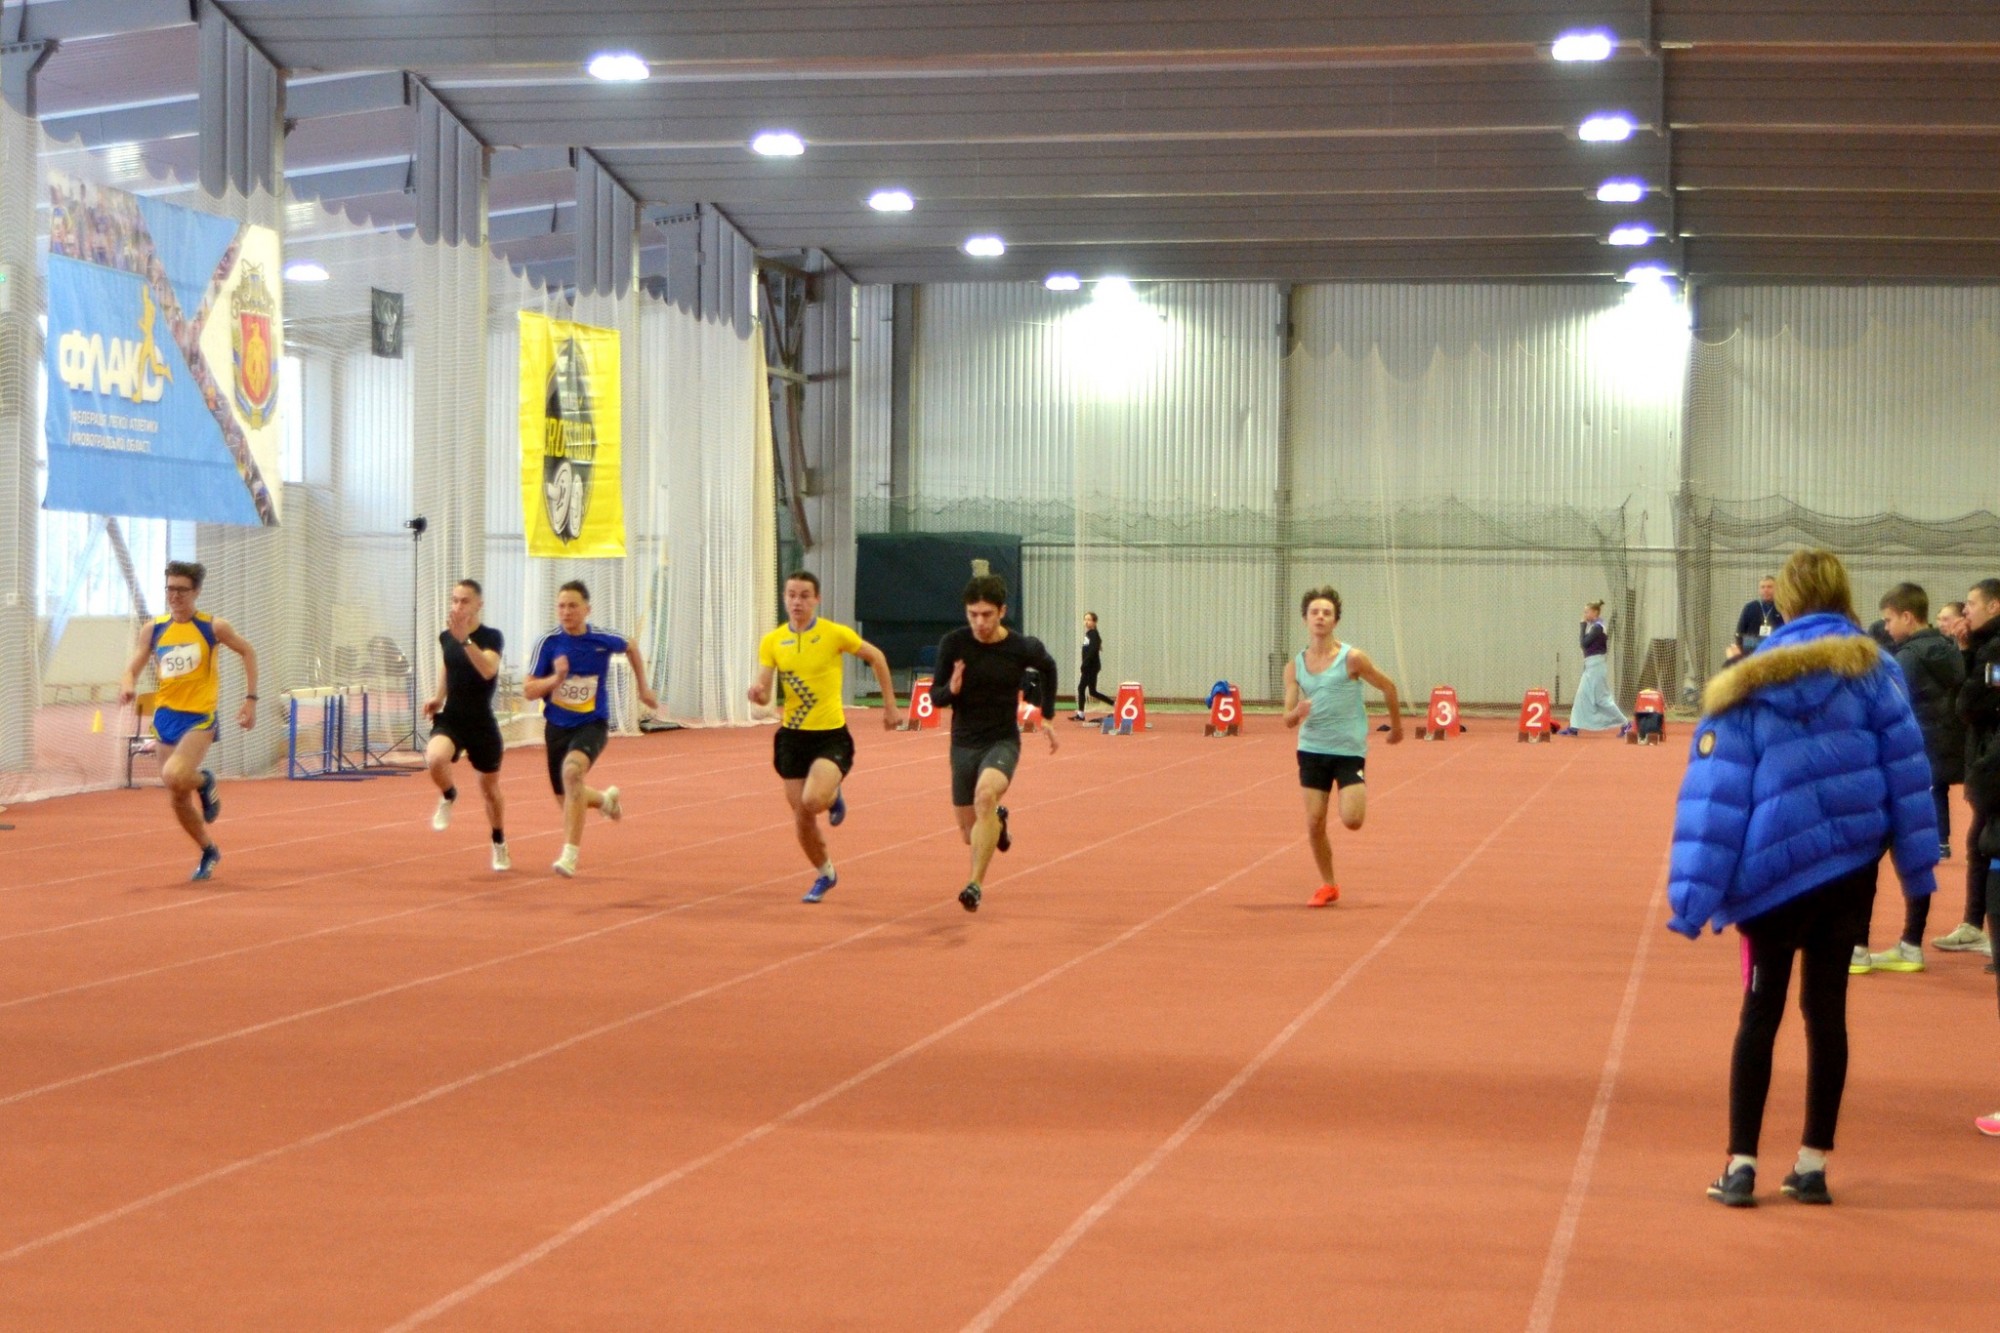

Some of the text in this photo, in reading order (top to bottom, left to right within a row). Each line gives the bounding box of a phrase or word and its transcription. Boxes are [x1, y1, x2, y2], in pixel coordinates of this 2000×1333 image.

[166, 656, 194, 672] 591
[560, 683, 590, 701] 589
[917, 693, 933, 718] 8
[1121, 697, 1138, 720] 6
[1217, 697, 1235, 722] 5
[1435, 701, 1452, 726] 3
[1525, 702, 1543, 728] 2
